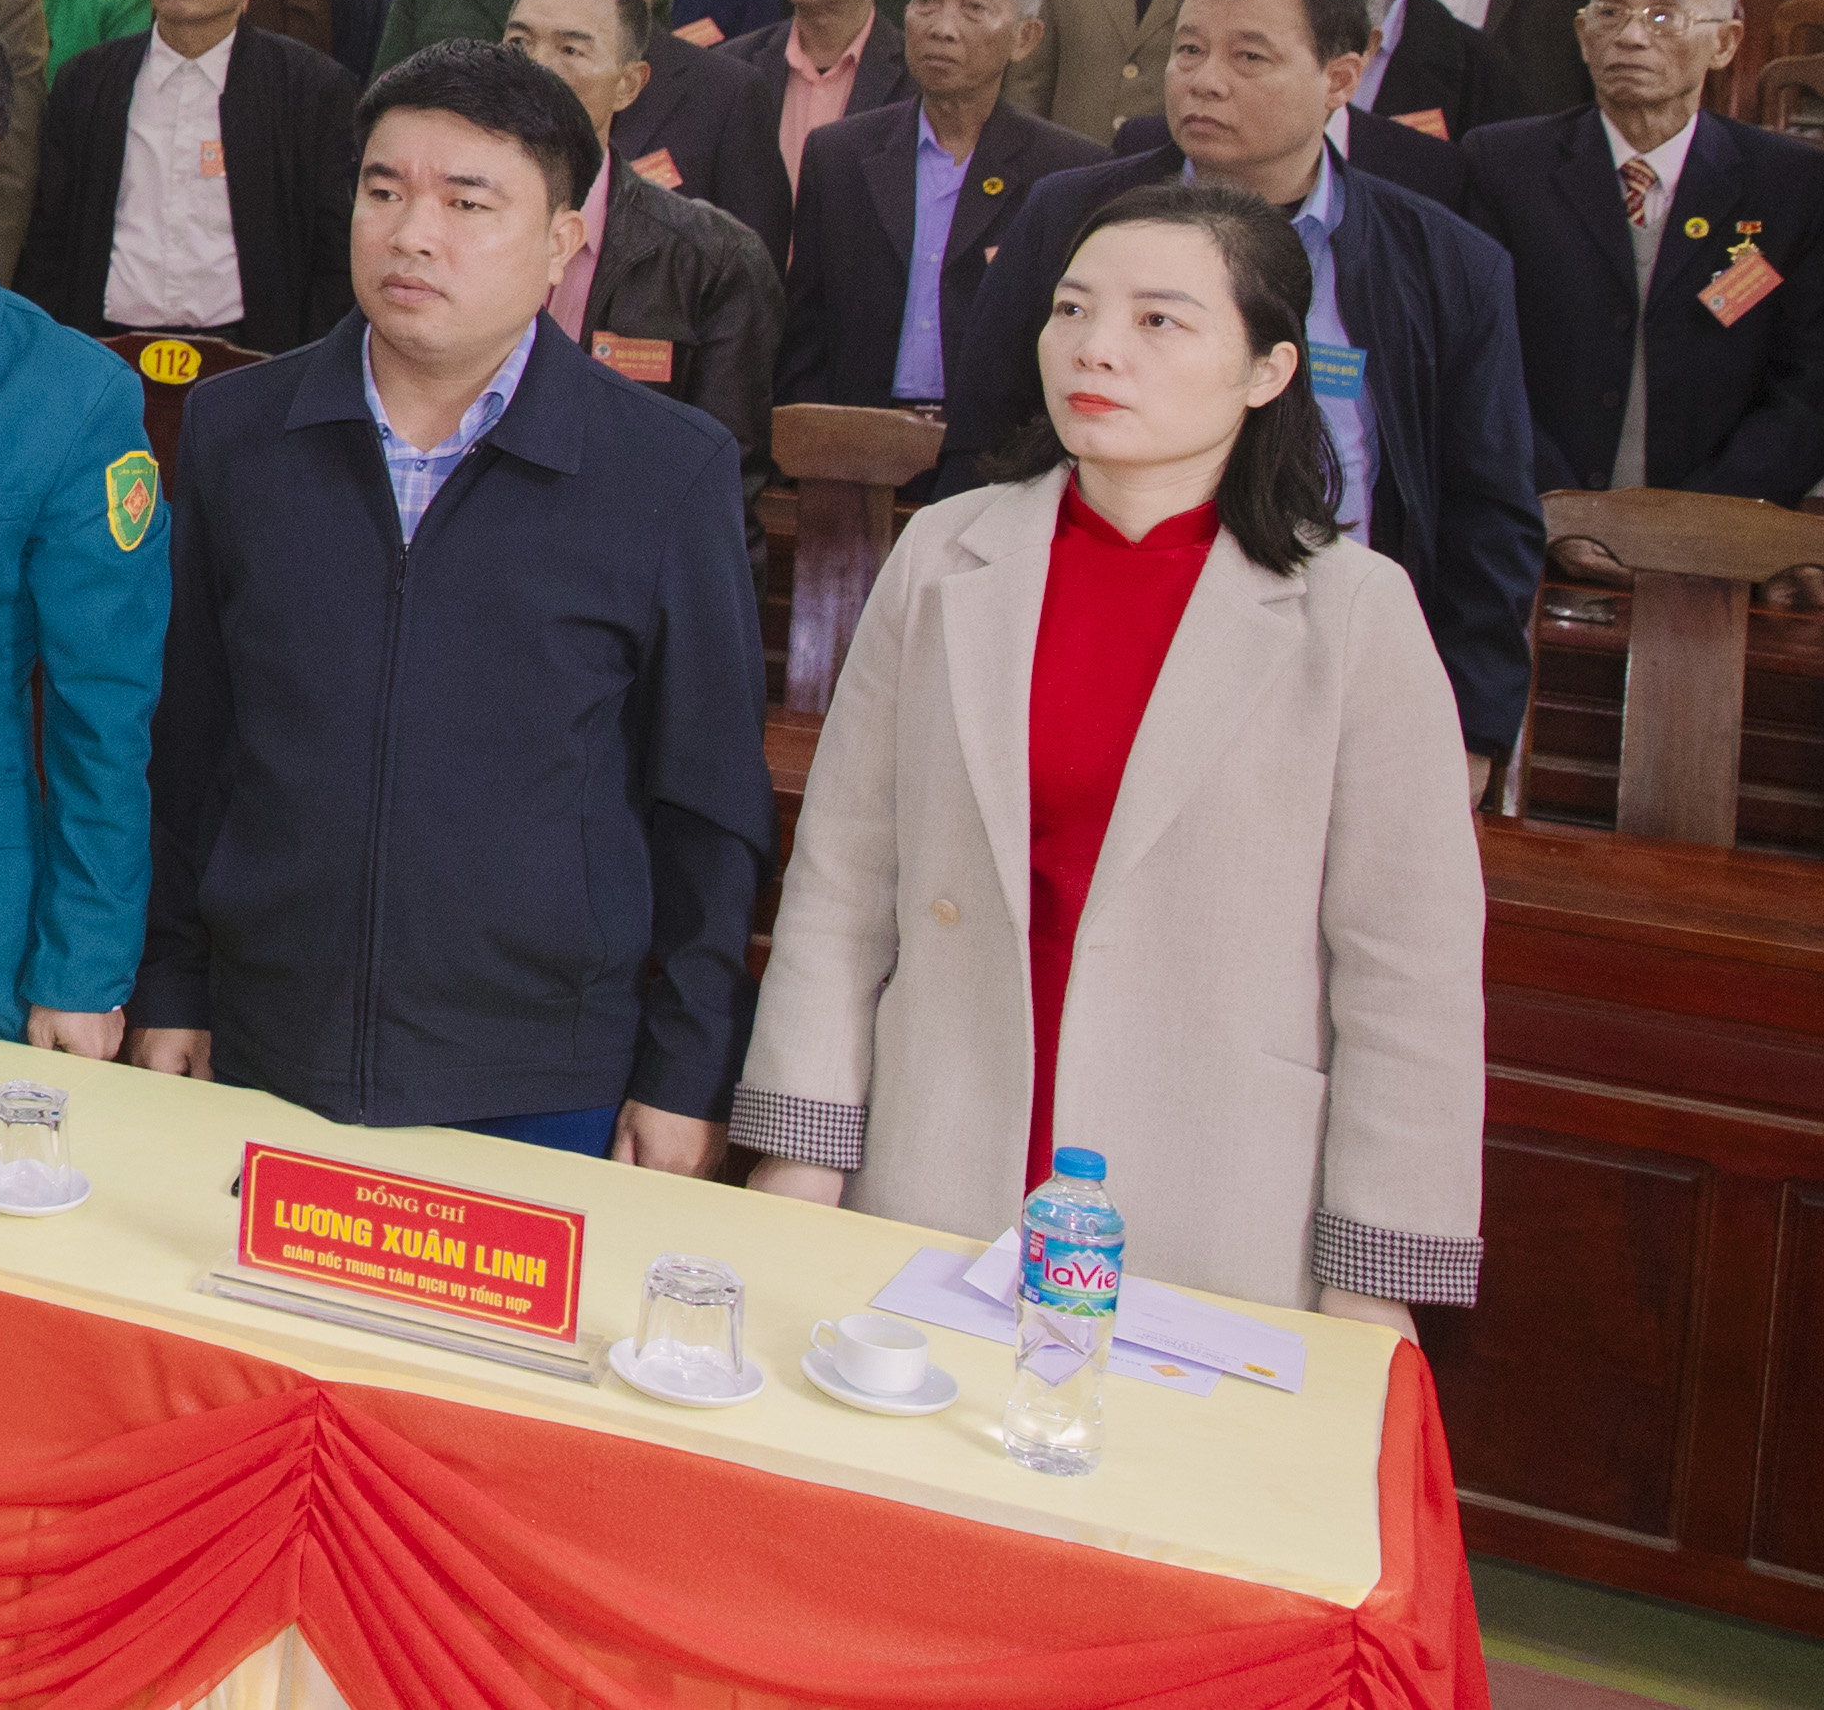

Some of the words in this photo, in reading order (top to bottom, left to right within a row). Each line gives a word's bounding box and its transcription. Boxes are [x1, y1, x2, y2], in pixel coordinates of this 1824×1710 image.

[155, 346, 191, 378] 112
[356, 1185, 419, 1215] ĐỒNG
[425, 1201, 466, 1224] CHÍ
[275, 1198, 372, 1248] LƯƠNG
[381, 1223, 466, 1269] XUÂN
[475, 1244, 546, 1287] LINH
[283, 1243, 314, 1263] GIÁM
[317, 1247, 342, 1270] ĐỐC
[345, 1257, 385, 1280] TRUNG
[389, 1264, 415, 1287] TÂM
[417, 1273, 448, 1296] DỊCH
[450, 1281, 467, 1302] VỤ
[469, 1283, 503, 1307] TỔNG
[505, 1296, 533, 1316] HỢP
[1044, 1258, 1118, 1290] laVie
